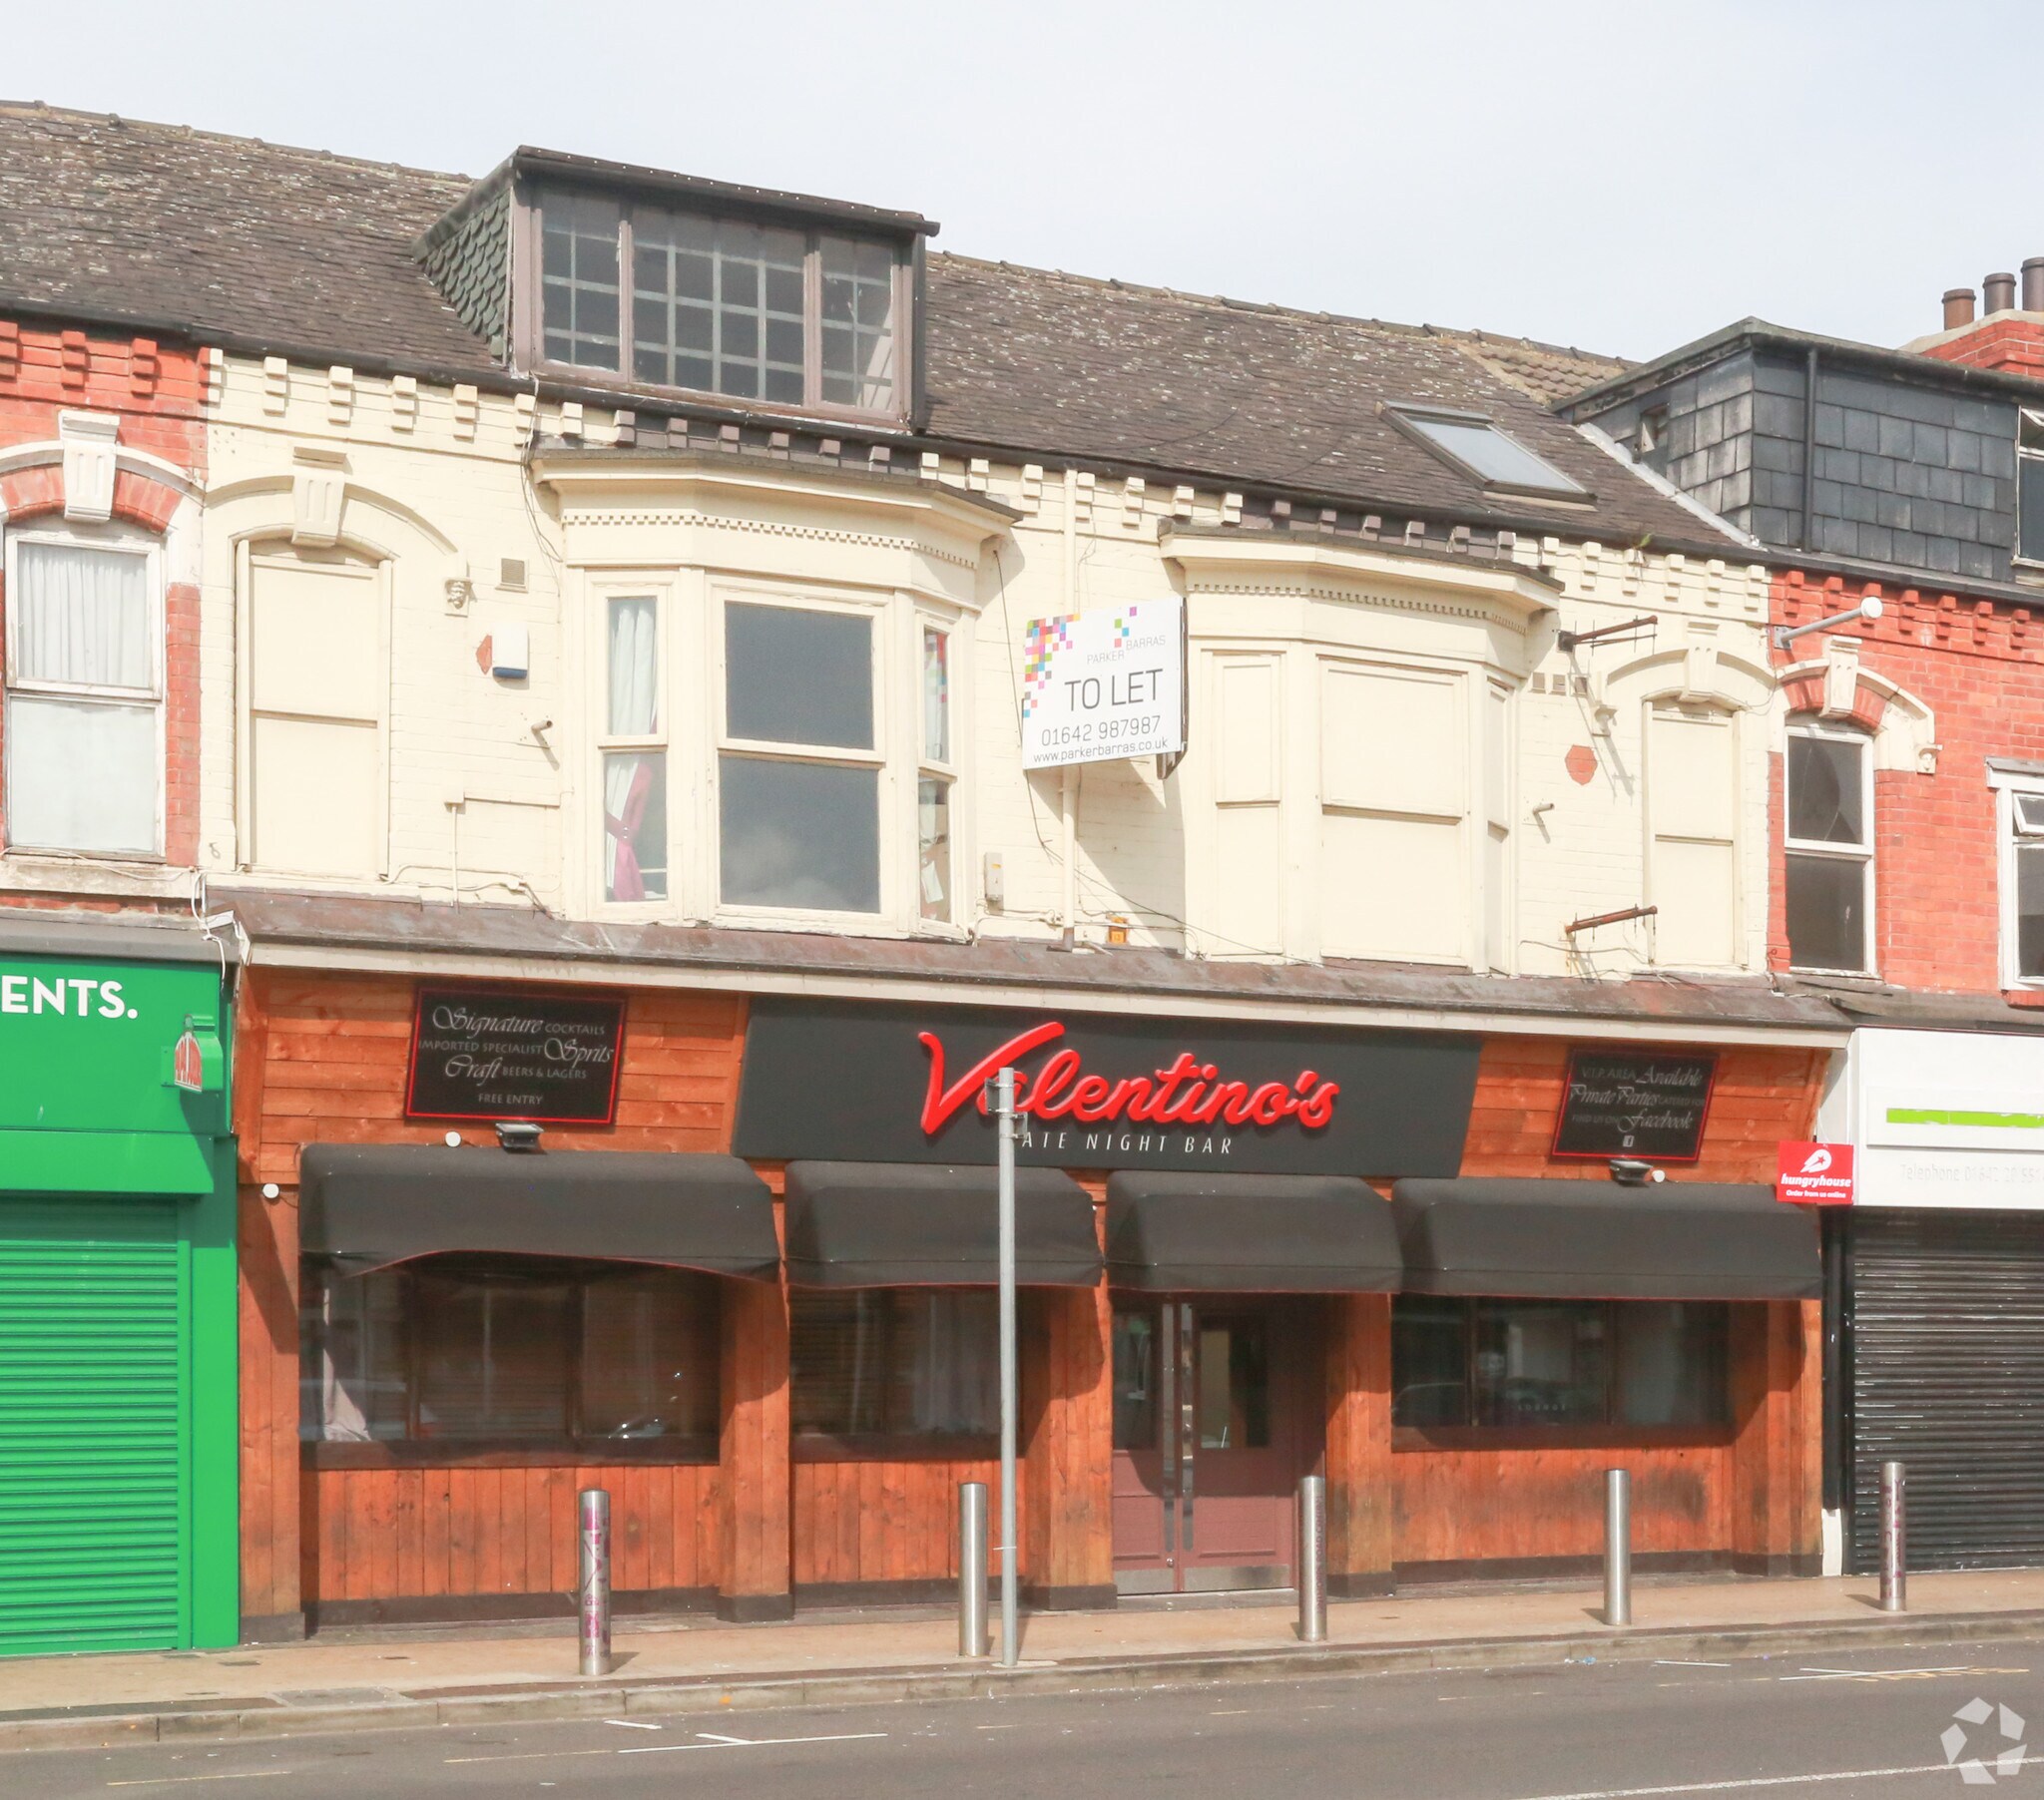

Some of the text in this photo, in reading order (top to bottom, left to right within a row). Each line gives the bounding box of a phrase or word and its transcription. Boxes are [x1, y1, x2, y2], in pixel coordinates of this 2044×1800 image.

[1126, 636, 1166, 651] BARRAS
[1087, 651, 1125, 665] PARKER
[1064, 669, 1164, 711] TO LET
[1041, 715, 1161, 746] 01642 987987
[1033, 736, 1168, 762] www.parkerbarras.co.uk
[432, 1006, 605, 1039] Signature COCKTAILS
[419, 1040, 479, 1053] IMPORTED
[482, 1042, 544, 1055] SPECIALIST
[444, 1054, 587, 1088] Craft BEERS & LAGERS
[478, 1094, 544, 1106] FREE ENTRY
[1020, 1130, 1233, 1155] ATE NIGHT BAR
[1781, 1172, 1852, 1187] hungryhouse
[1900, 1164, 1960, 1184] Telephone
